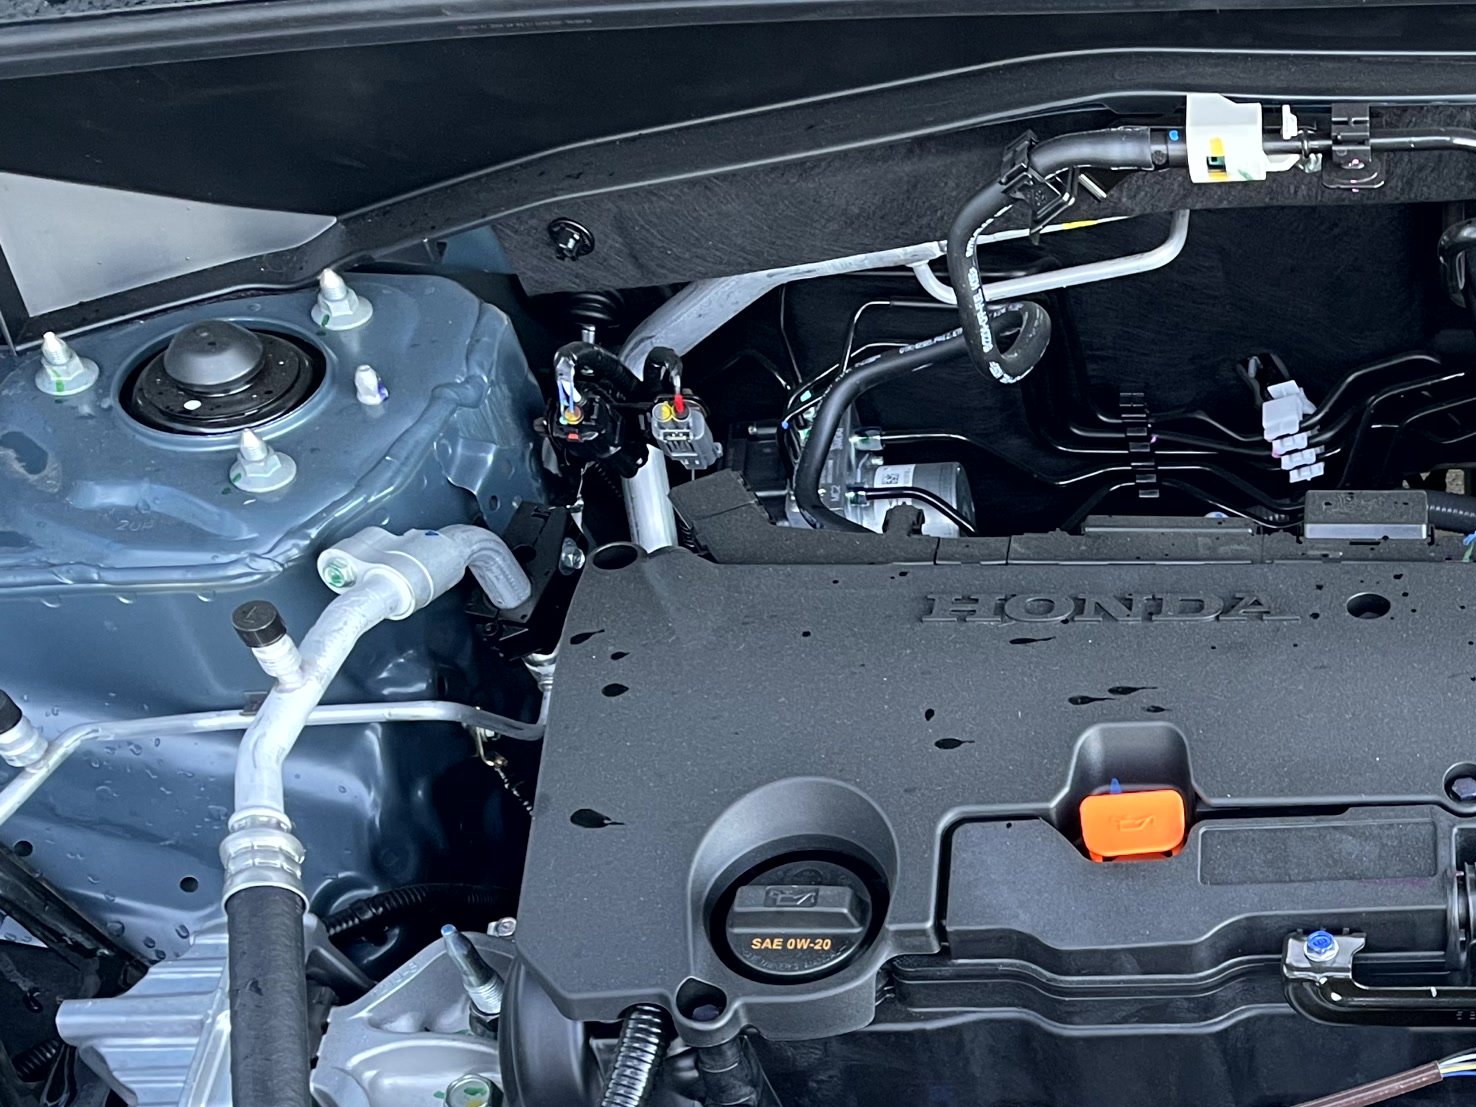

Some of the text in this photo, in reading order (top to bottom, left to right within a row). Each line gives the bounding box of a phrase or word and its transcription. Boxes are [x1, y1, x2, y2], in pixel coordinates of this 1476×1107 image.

[921, 593, 1301, 624] HONDA
[751, 938, 832, 950] SAE 0W-20
